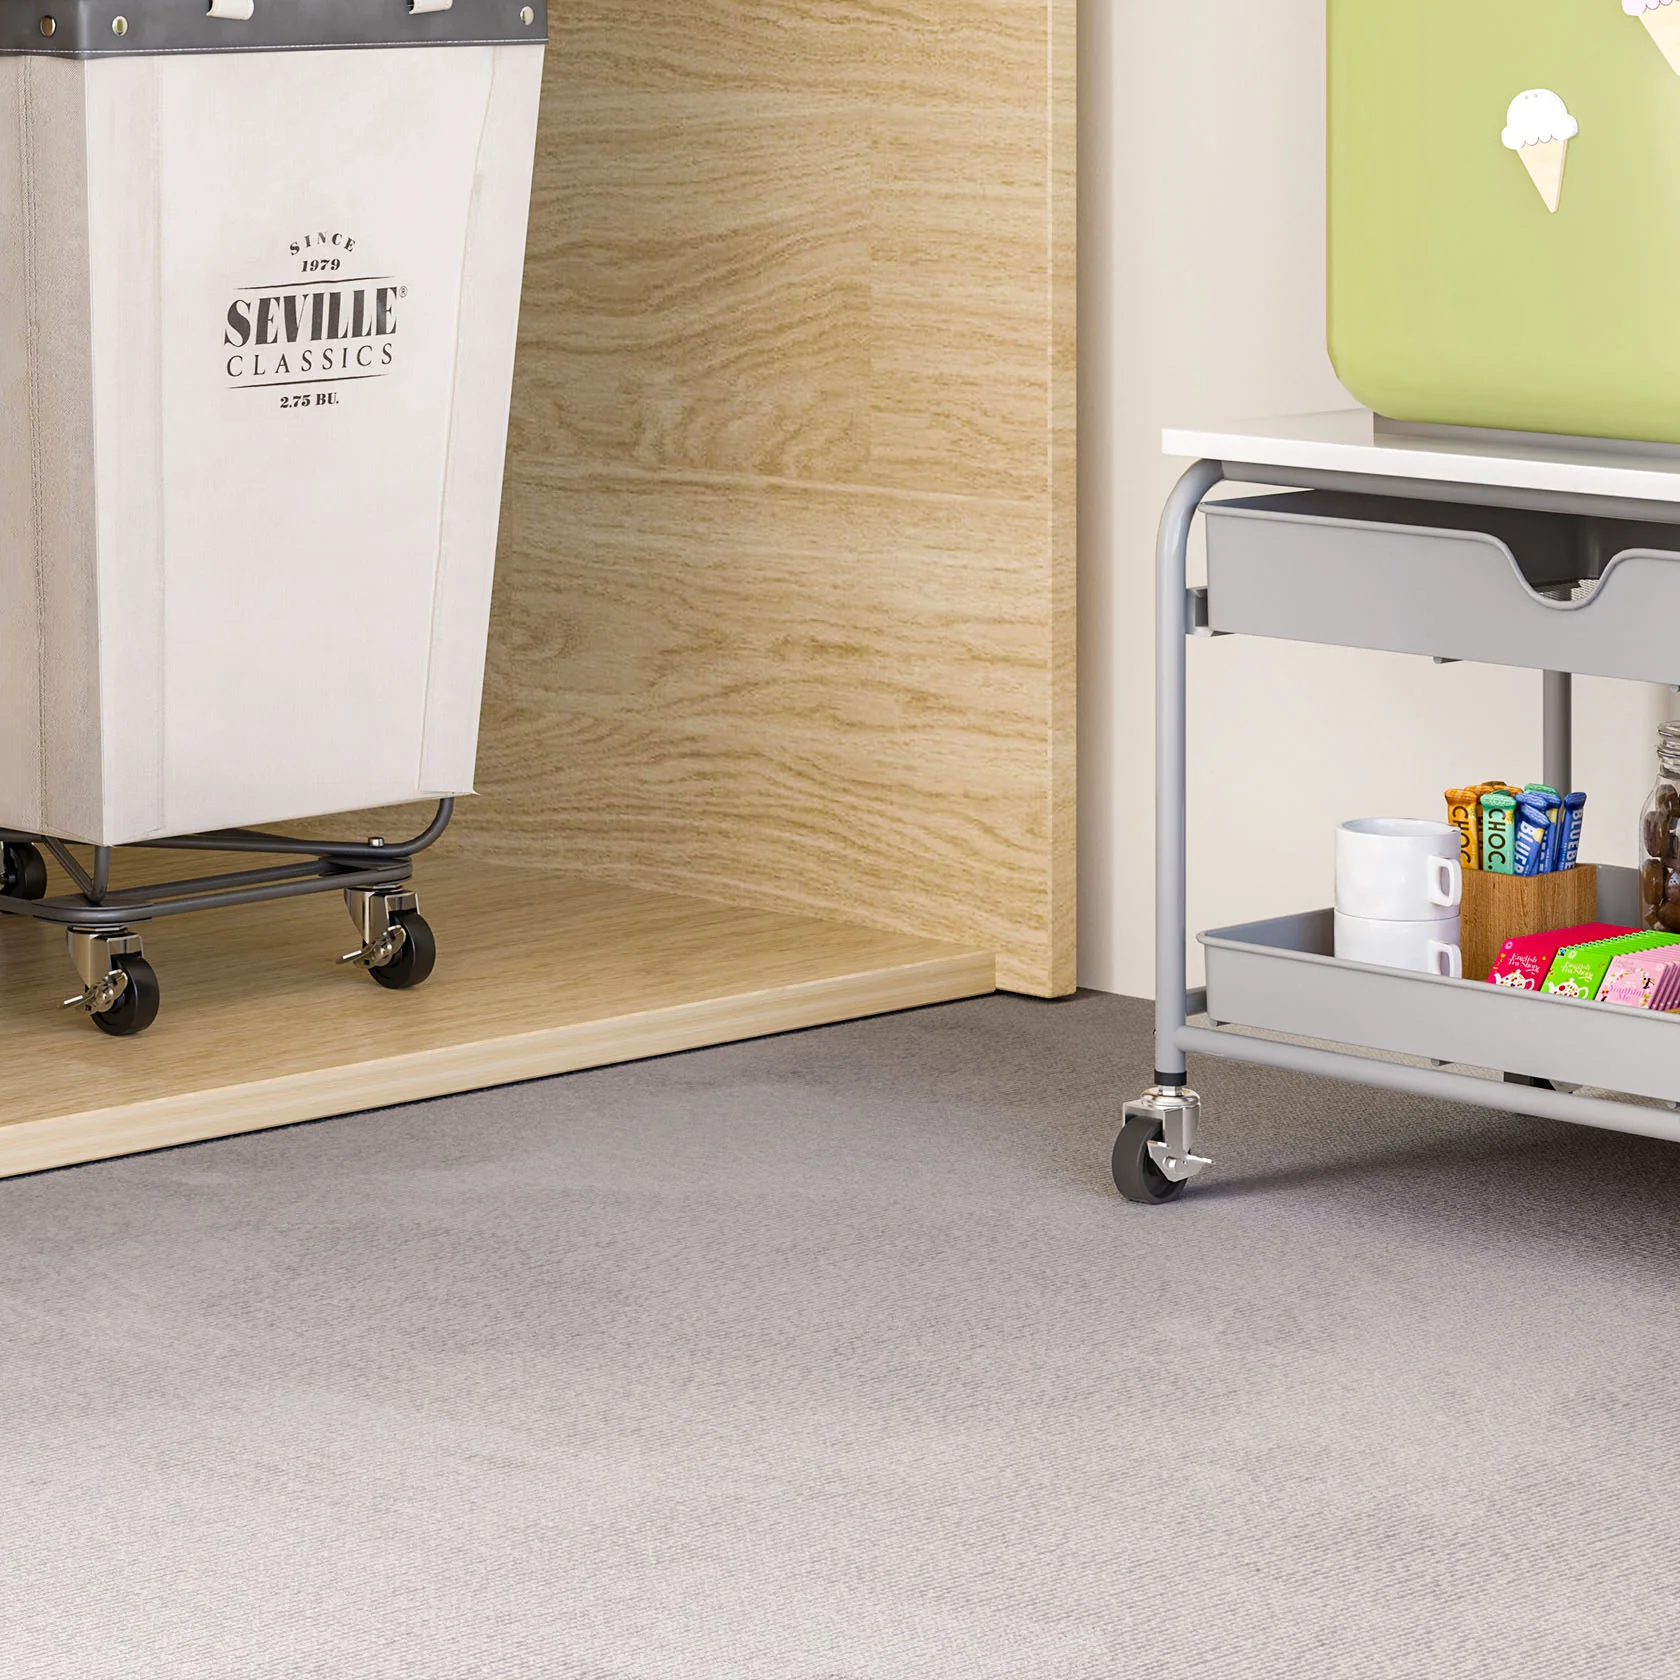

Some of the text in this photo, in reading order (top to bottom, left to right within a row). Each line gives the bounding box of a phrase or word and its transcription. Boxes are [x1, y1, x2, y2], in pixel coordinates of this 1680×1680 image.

[289, 231, 356, 256] SINCE
[301, 258, 341, 273] 1979
[226, 342, 393, 378] CLASSICS
[280, 392, 340, 409] 2.75 BU.
